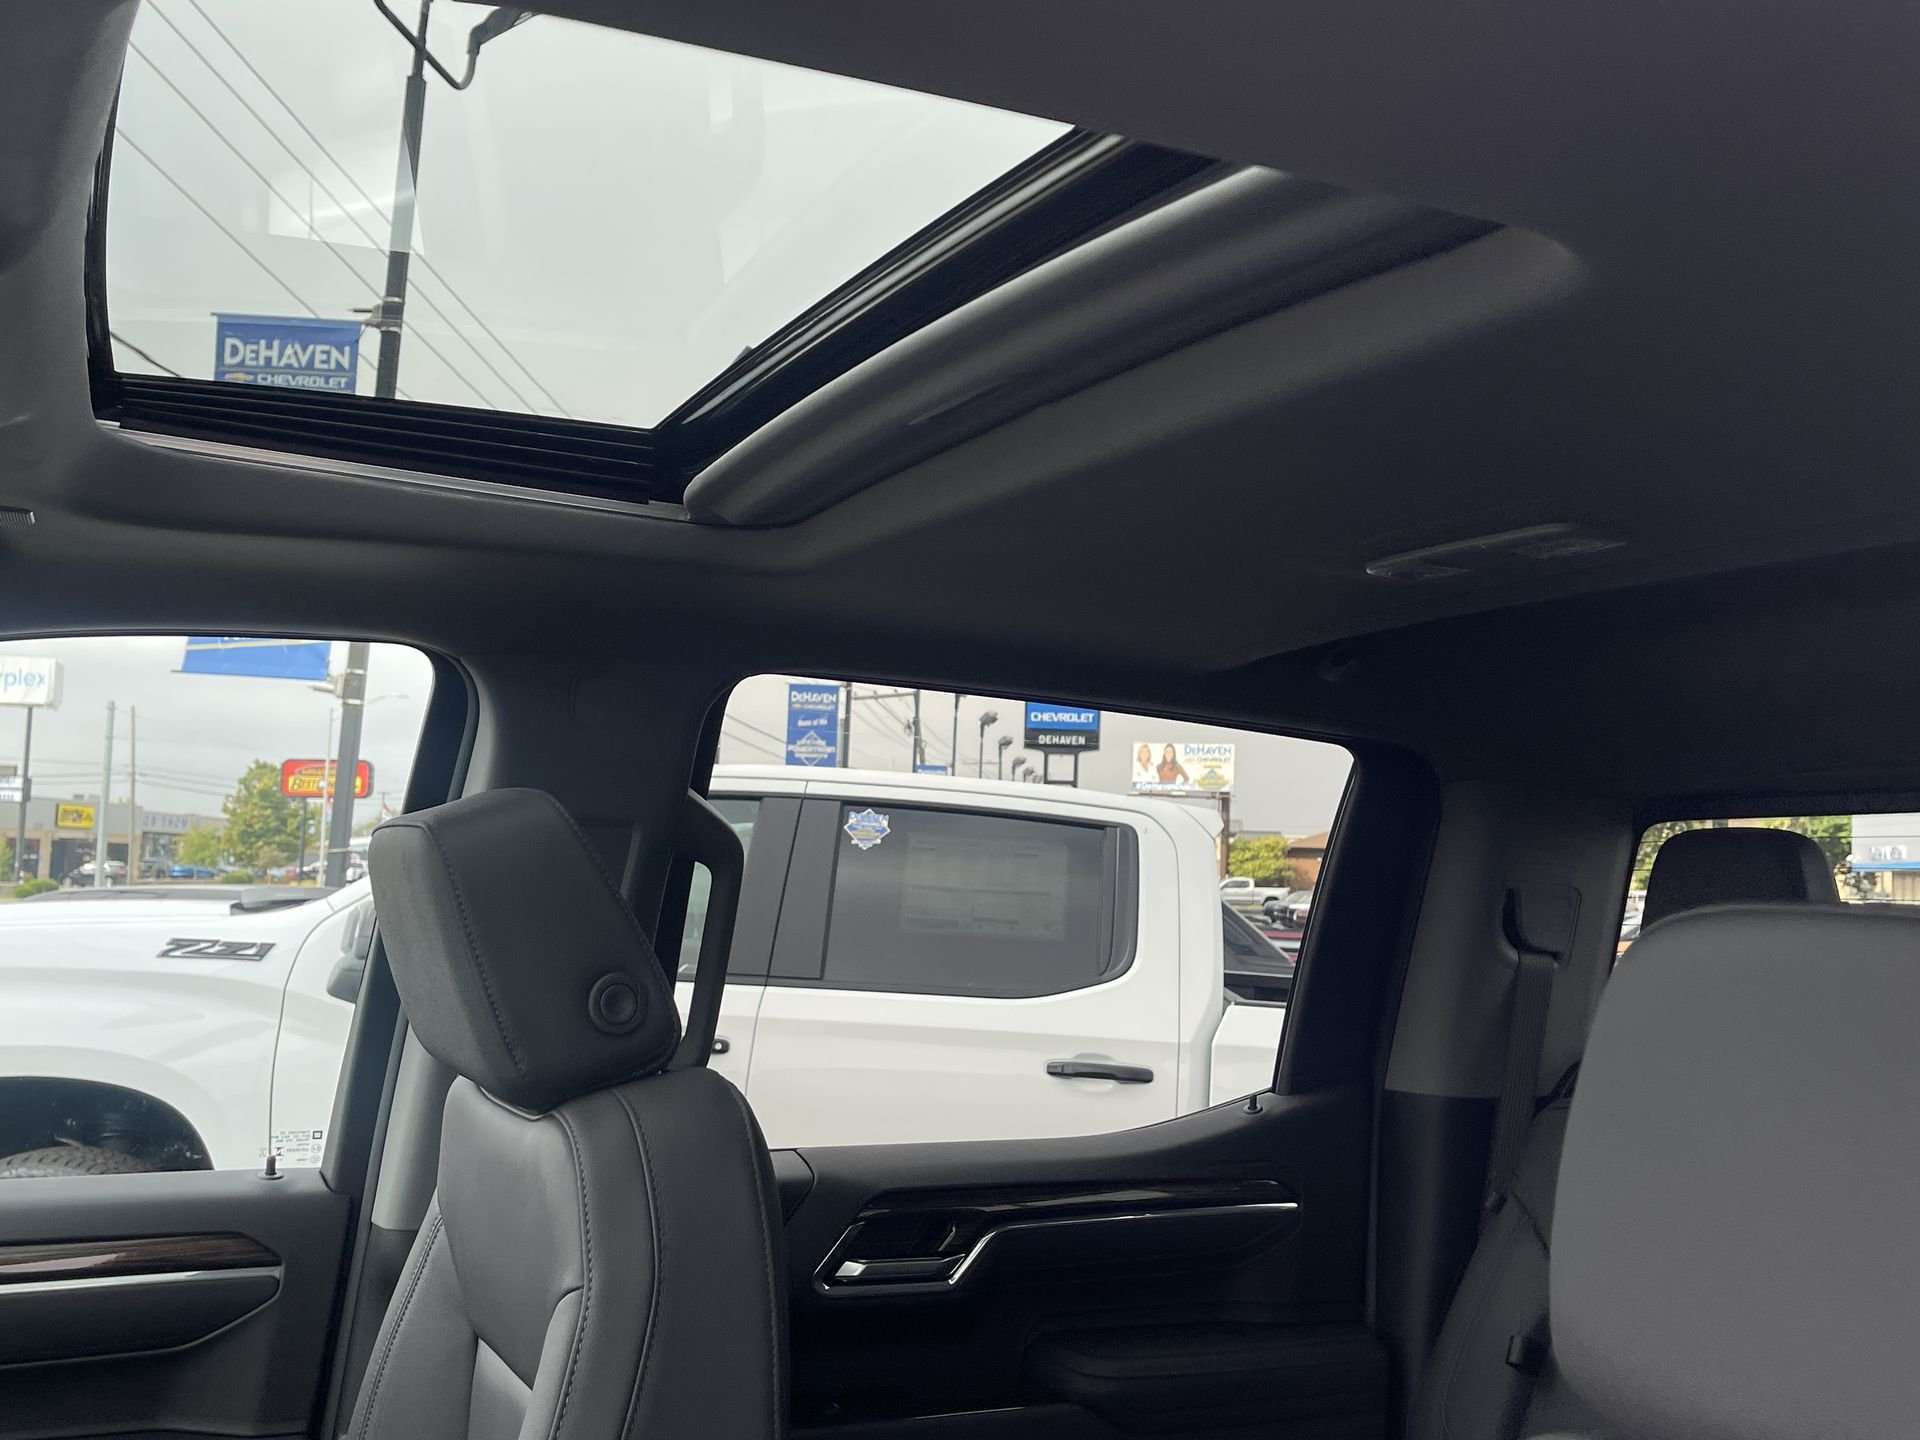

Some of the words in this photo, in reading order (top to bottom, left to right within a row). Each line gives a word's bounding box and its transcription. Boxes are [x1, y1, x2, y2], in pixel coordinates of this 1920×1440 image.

[257, 373, 348, 389] CHEVROLET
[1030, 711, 1095, 723] CHEVROLET
[1038, 735, 1086, 746] DEHAVEN
[156, 938, 277, 962] Z71
